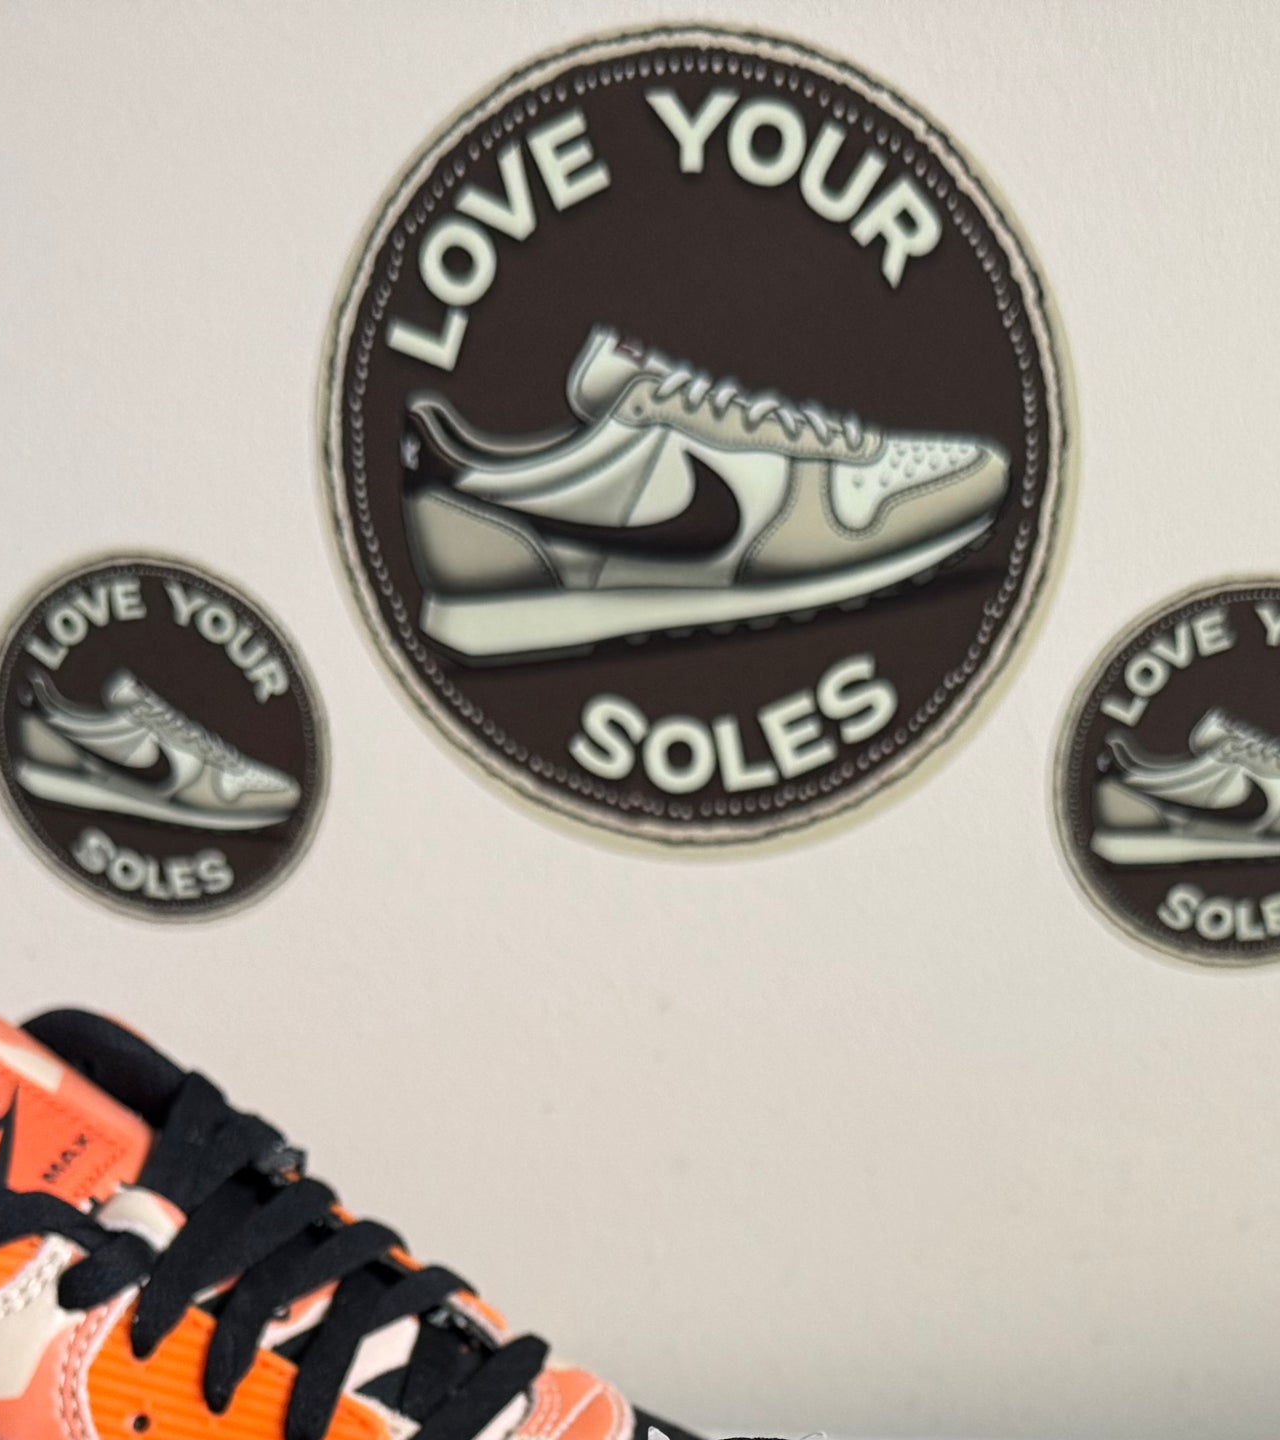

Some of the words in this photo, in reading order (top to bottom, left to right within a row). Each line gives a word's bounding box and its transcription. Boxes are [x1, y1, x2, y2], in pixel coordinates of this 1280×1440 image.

[385, 110, 612, 372] LOVE
[645, 87, 944, 289] YOUR
[25, 576, 147, 671] LOVE
[163, 580, 291, 704] YOUR
[1099, 606, 1235, 727] LOVE
[569, 654, 899, 795] SOLES
[73, 826, 235, 900] SOLES
[42, 1133, 89, 1184] MAX
